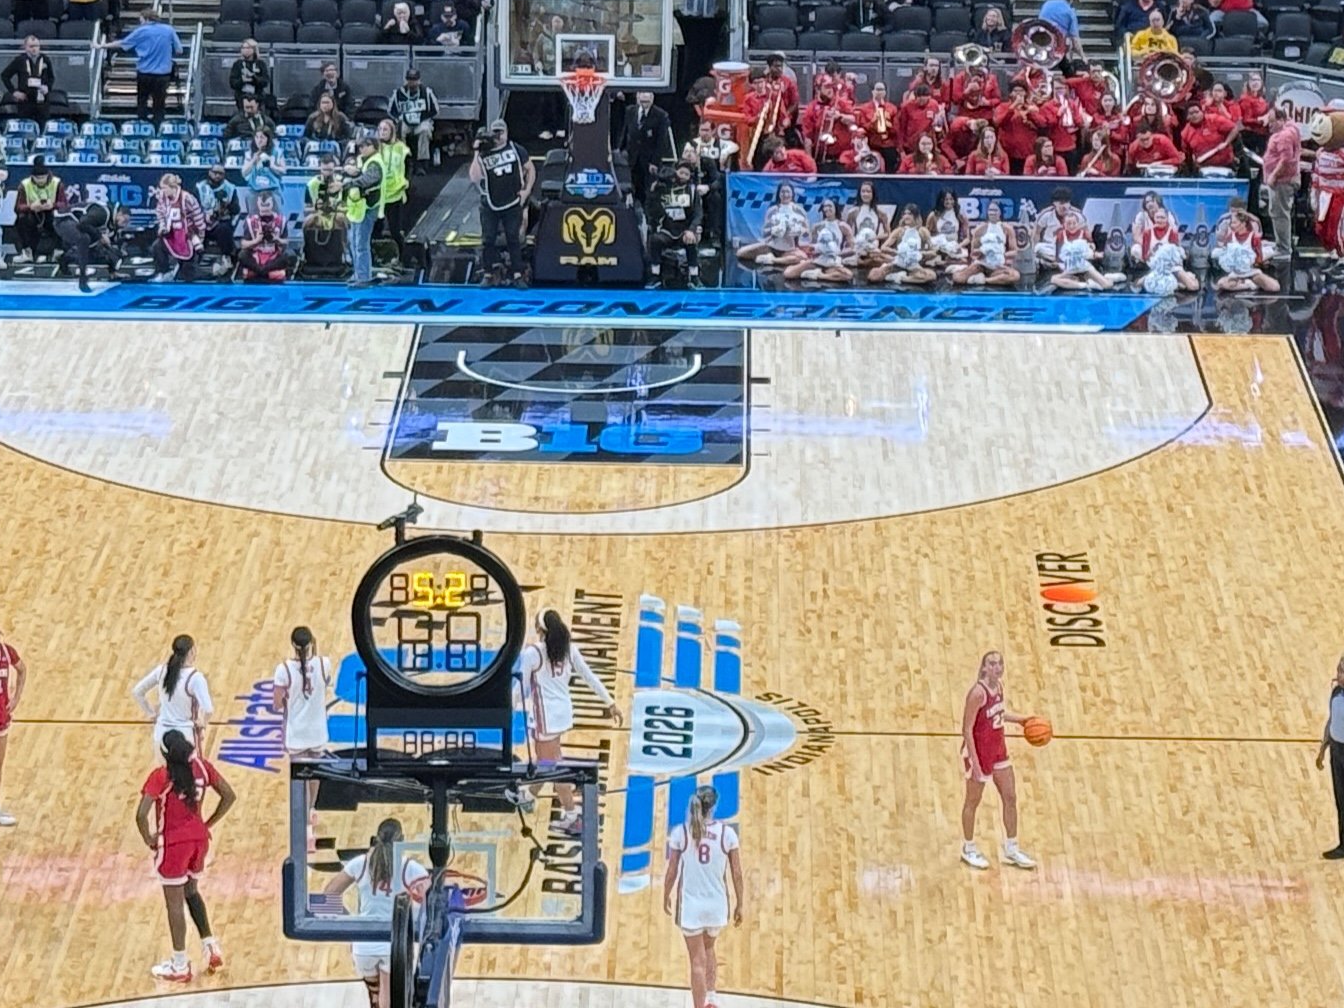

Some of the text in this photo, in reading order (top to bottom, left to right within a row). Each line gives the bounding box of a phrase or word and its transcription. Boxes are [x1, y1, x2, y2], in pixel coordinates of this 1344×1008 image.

[559, 256, 618, 266] RAM
[127, 294, 1052, 325] BIG TEN CONFERENCE
[1035, 551, 1107, 648] DISCOVER
[642, 704, 695, 760] 2026
[751, 692, 836, 776] INDIANAPOLIS
[698, 843, 710, 864] 8
